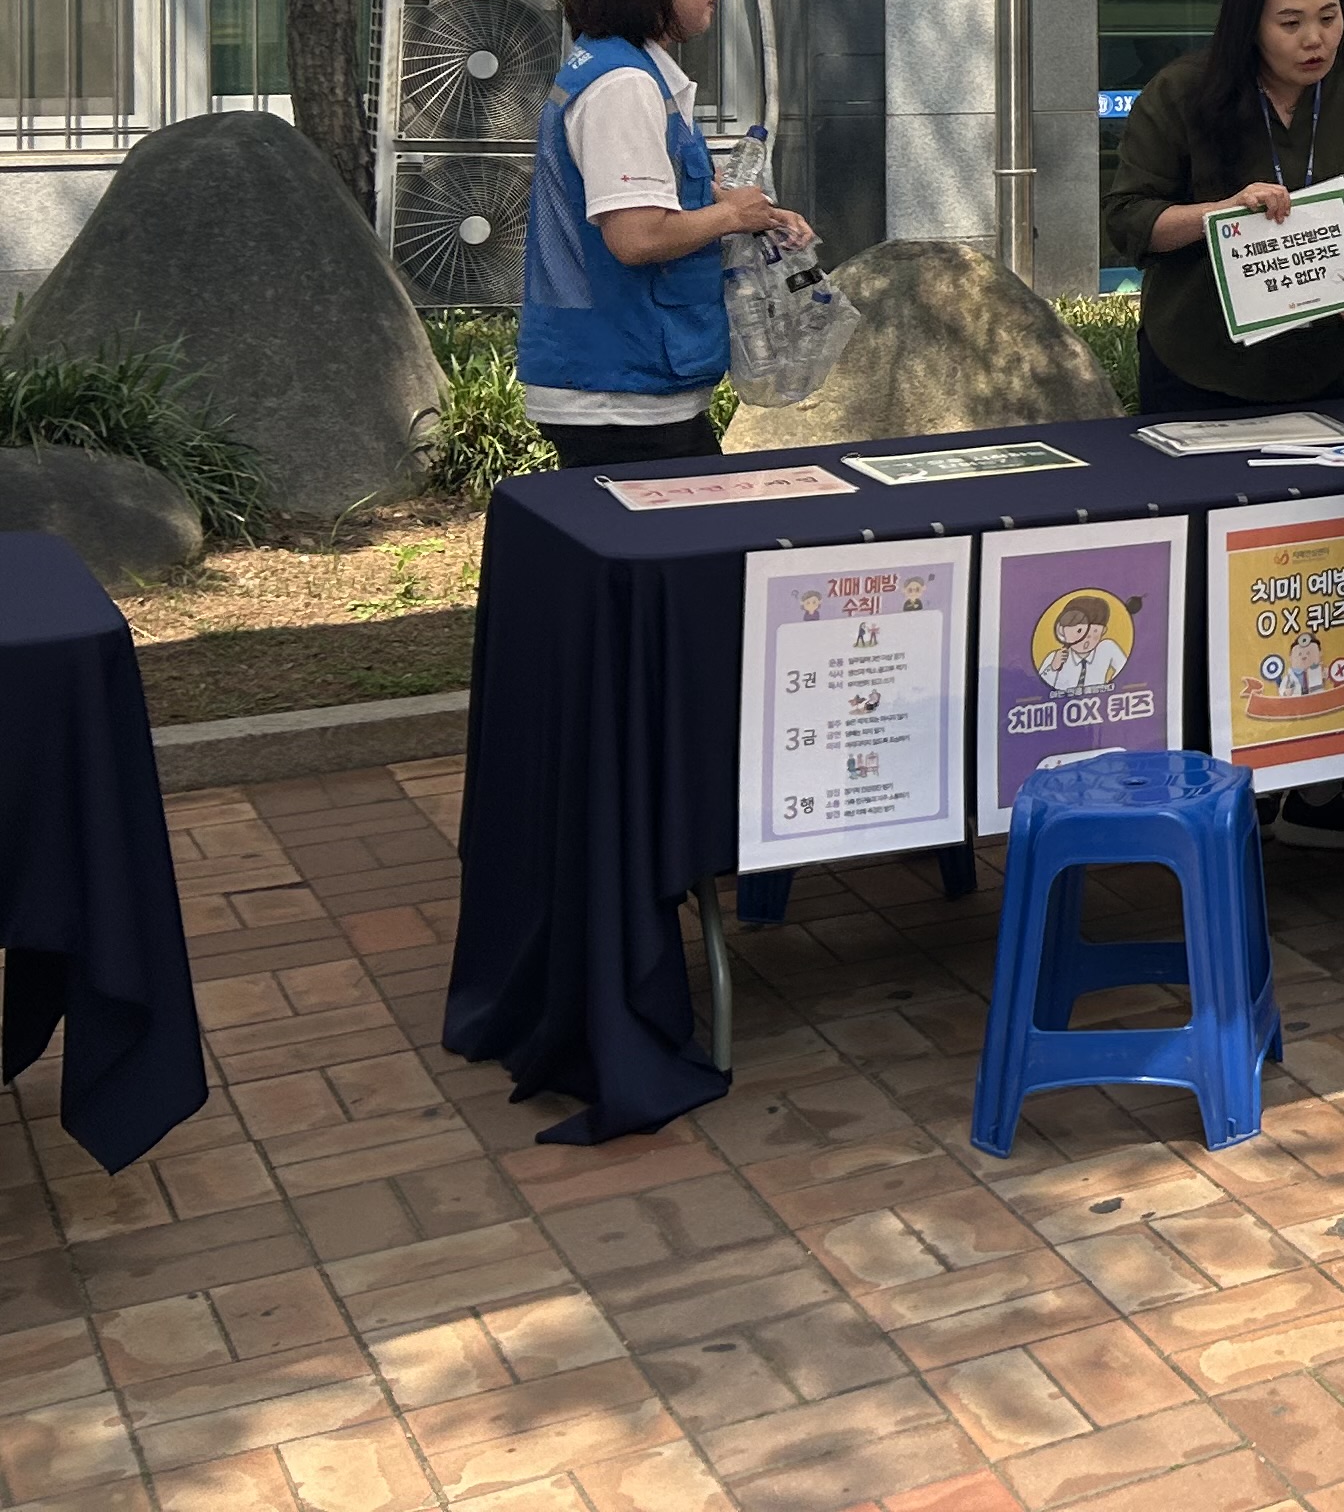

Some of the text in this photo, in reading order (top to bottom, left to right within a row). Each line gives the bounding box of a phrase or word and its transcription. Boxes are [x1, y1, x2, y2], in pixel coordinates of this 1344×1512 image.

[1221, 222, 1242, 238] OX
[1231, 224, 1342, 260] 4. 치매로 진단받으면
[1242, 244, 1341, 278] 혼자서는 아무것도
[1264, 266, 1327, 293] 할 수 없다?
[827, 574, 899, 598] 치매 예방
[1251, 575, 1301, 605] 치매
[841, 596, 881, 617] 수칙!
[786, 670, 817, 694] 3권
[1008, 702, 1057, 734] 치매
[1063, 698, 1102, 726] OX
[1106, 690, 1154, 722] 퀴즈
[785, 728, 817, 751] 3금
[783, 795, 815, 820] 3행
